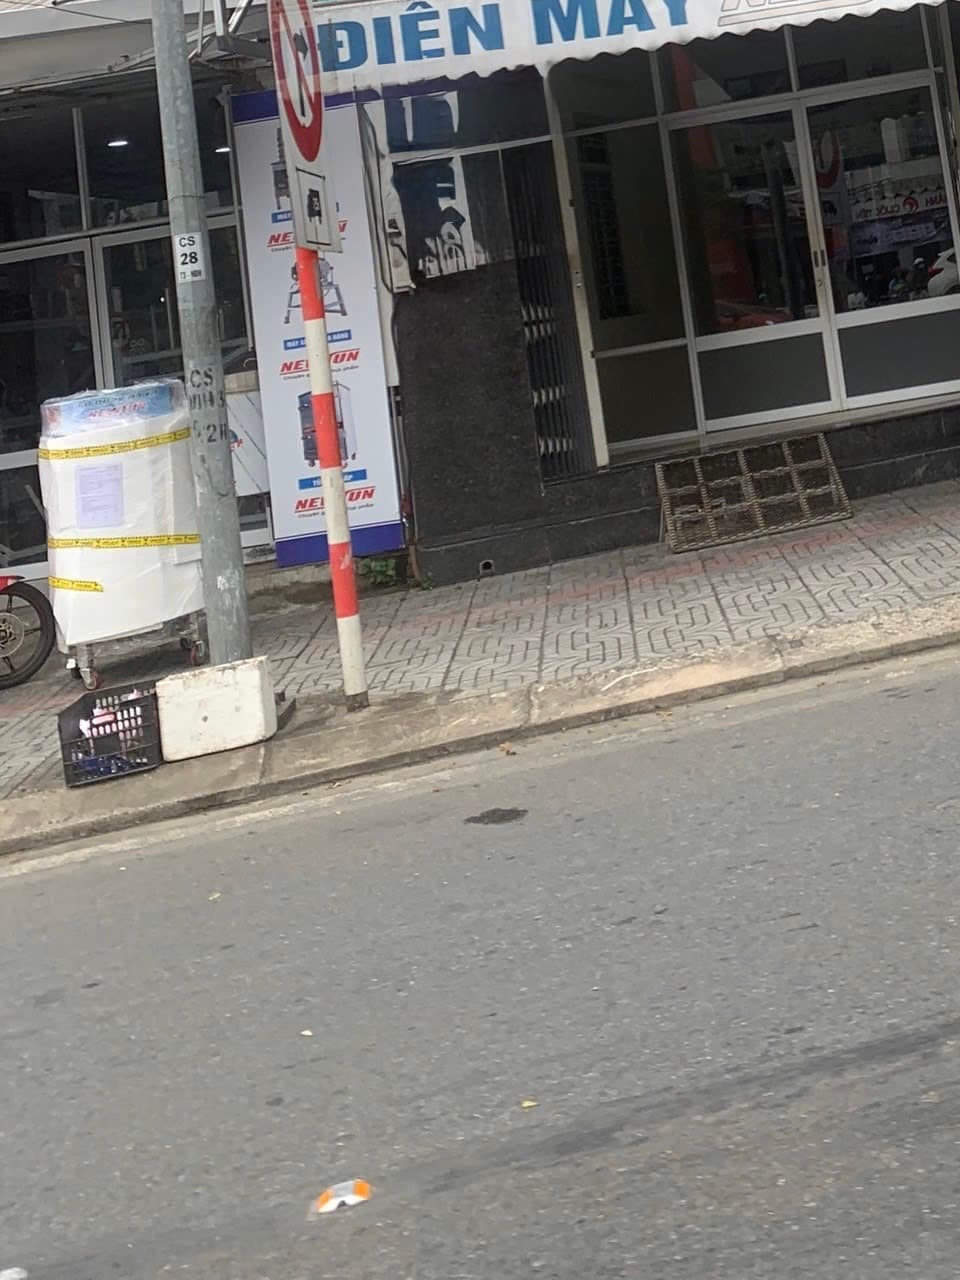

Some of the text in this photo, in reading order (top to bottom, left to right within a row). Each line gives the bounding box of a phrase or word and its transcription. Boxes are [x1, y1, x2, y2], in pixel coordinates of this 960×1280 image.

[179, 236, 195, 247] CS
[180, 252, 198, 266] 28
[280, 350, 360, 373] NEUN
[295, 488, 375, 511] NEUN
